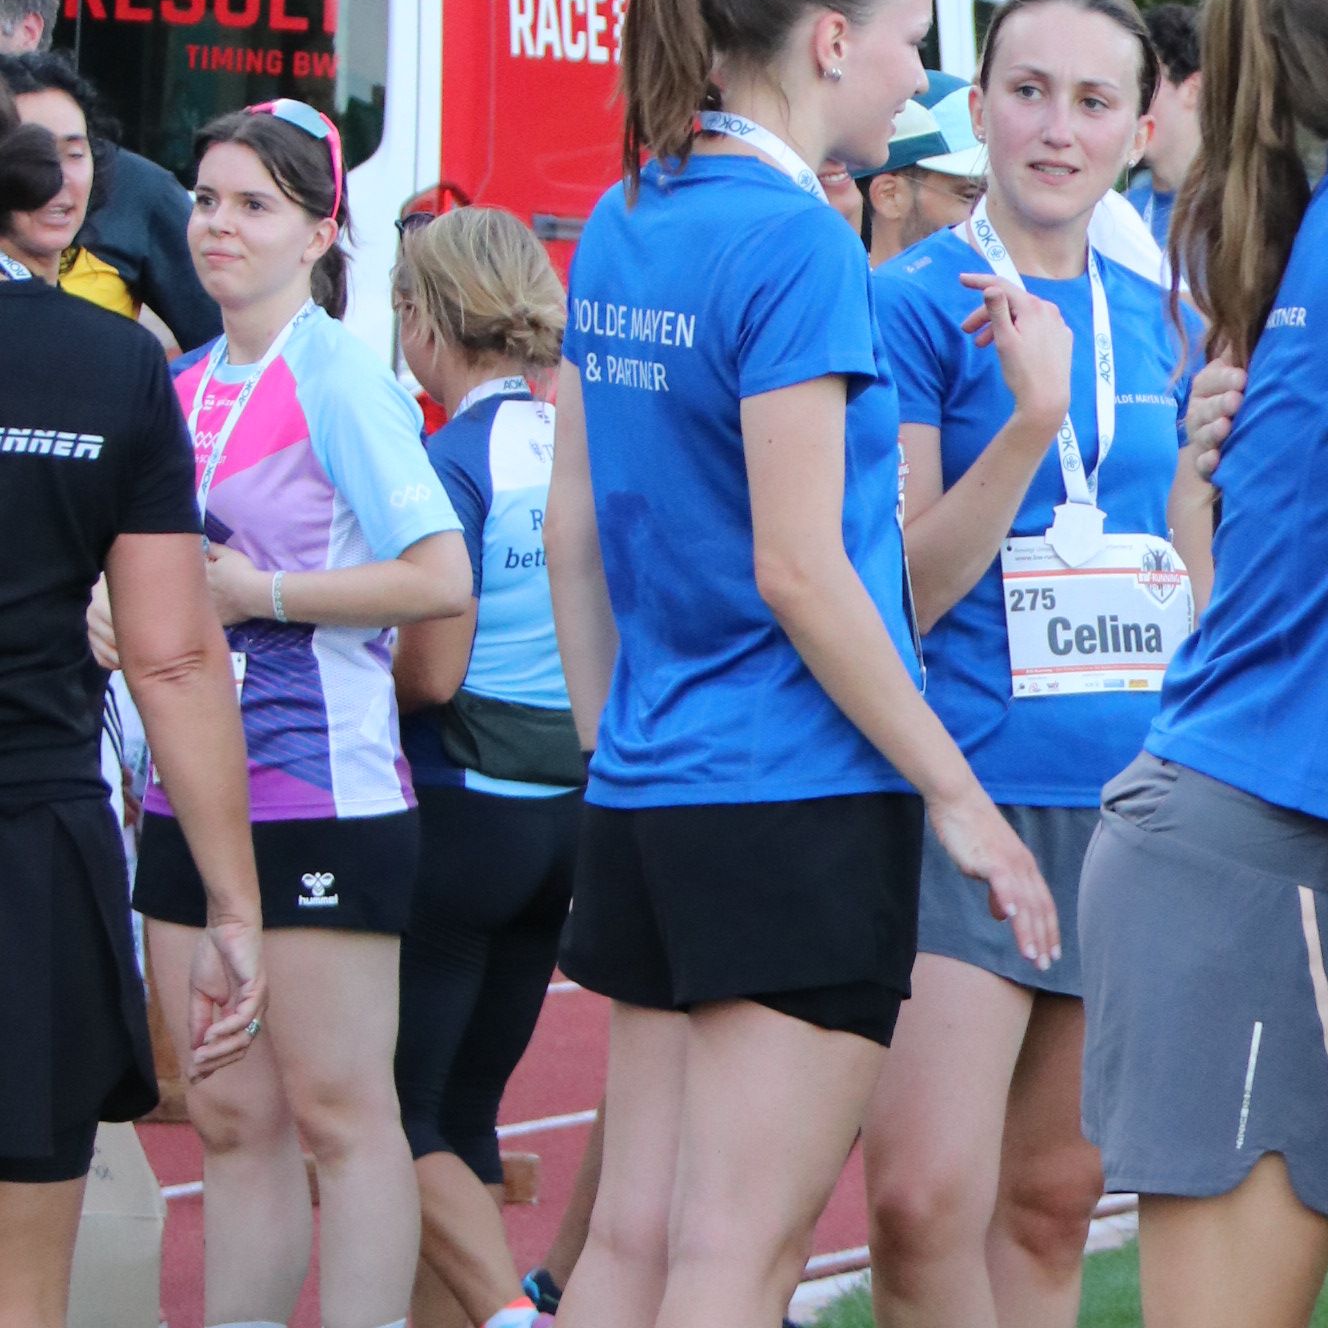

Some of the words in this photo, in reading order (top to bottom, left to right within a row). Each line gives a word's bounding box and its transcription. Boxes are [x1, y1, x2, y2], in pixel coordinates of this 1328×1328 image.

[186, 43, 284, 76] TIMING
[292, 50, 341, 78] BW
[719, 116, 757, 136] AOK
[974, 218, 998, 248] AOK
[630, 307, 697, 348] MAYEN
[585, 352, 602, 382] &
[606, 354, 670, 392] PARTNER
[1099, 350, 1113, 385] AOK
[237, 376, 256, 409] AOK
[0, 427, 105, 460] NNER
[1009, 587, 1057, 613] 275
[1046, 614, 1164, 657] Celina
